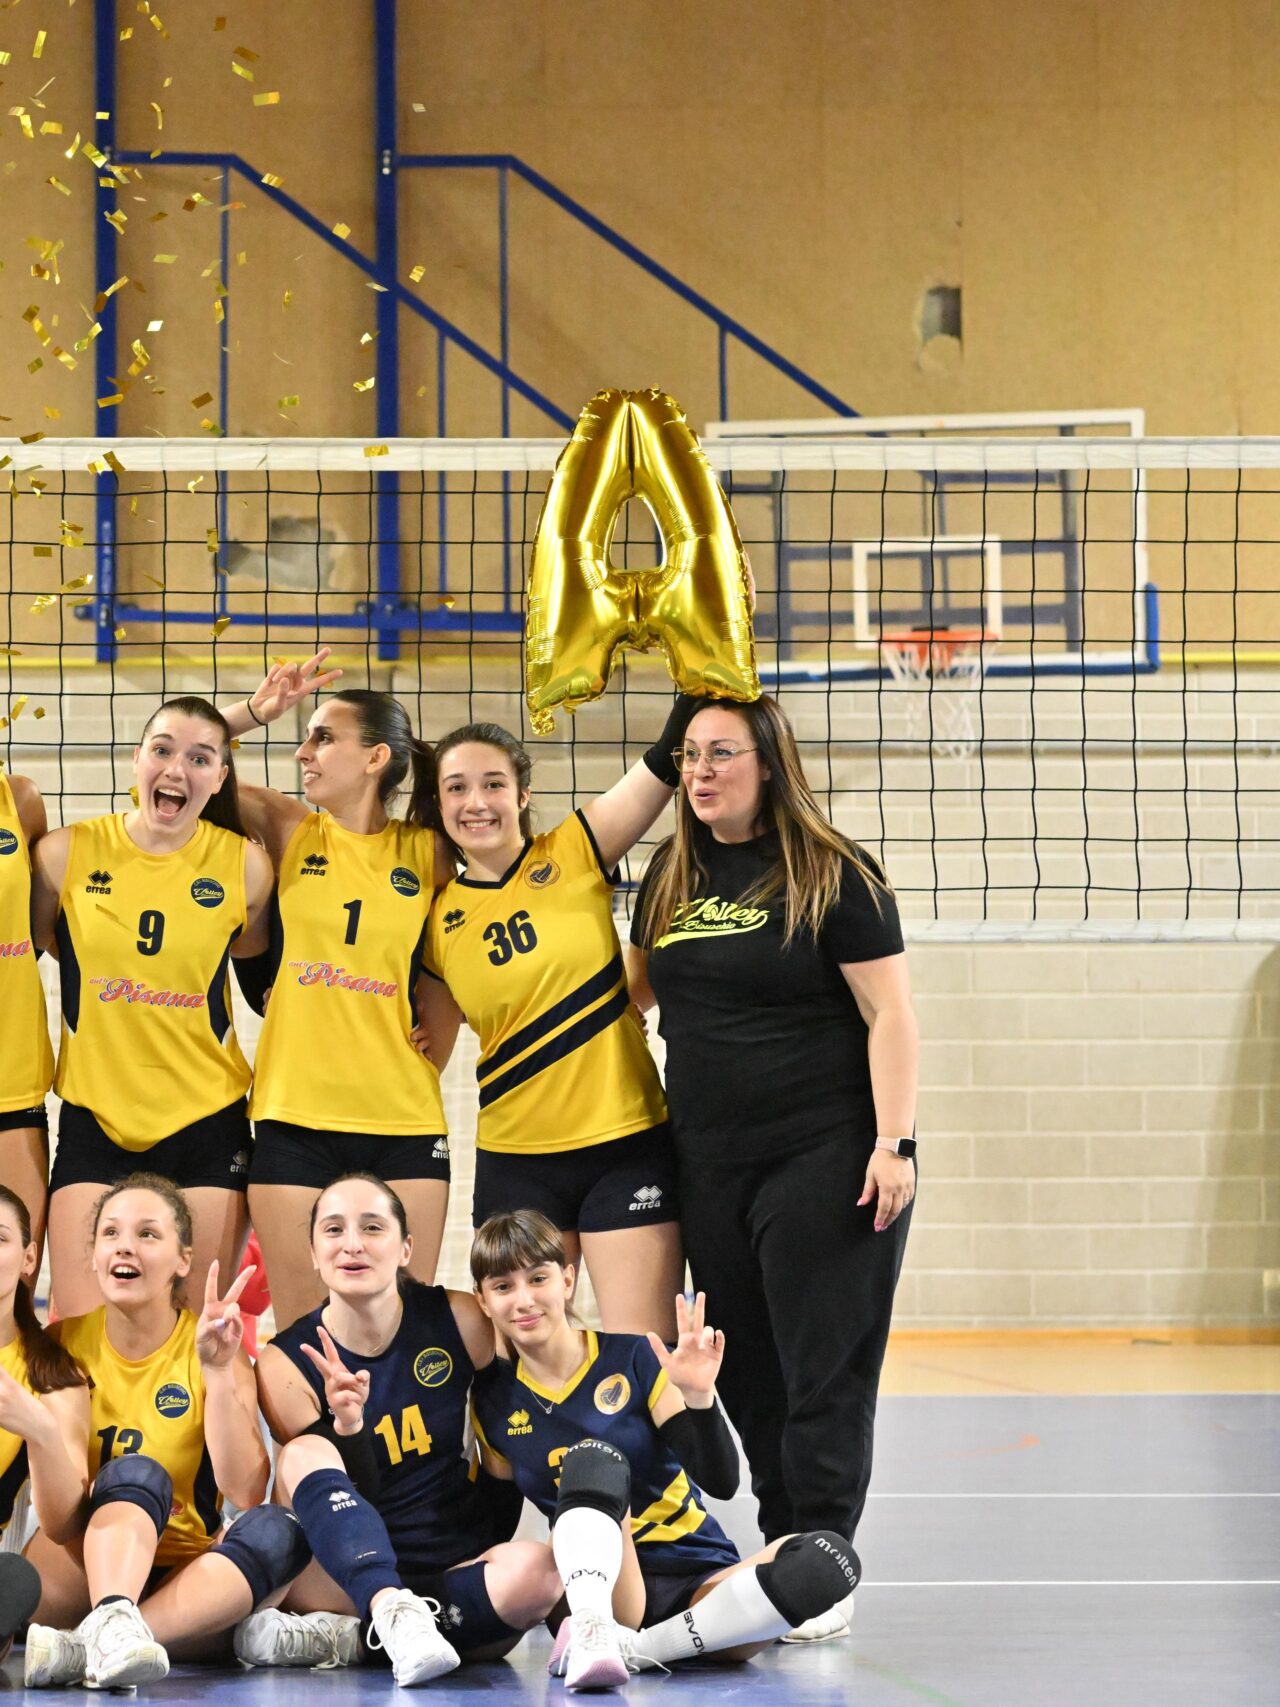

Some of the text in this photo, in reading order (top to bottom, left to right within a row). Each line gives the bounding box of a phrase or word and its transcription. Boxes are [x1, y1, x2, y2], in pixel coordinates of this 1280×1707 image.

[526, 388, 761, 722] A
[300, 867, 326, 877] errea
[85, 885, 112, 895] errea
[136, 910, 165, 956] 9
[343, 899, 362, 945] 1
[444, 919, 466, 934] errea
[482, 910, 538, 966] 36
[99, 978, 207, 1008] Pisana
[298, 962, 399, 997] Pisana
[629, 1200, 661, 1211] errea
[374, 1404, 432, 1465] 14
[507, 1424, 533, 1436] errea
[332, 1499, 358, 1512] errea
[814, 1537, 857, 1586] molten
